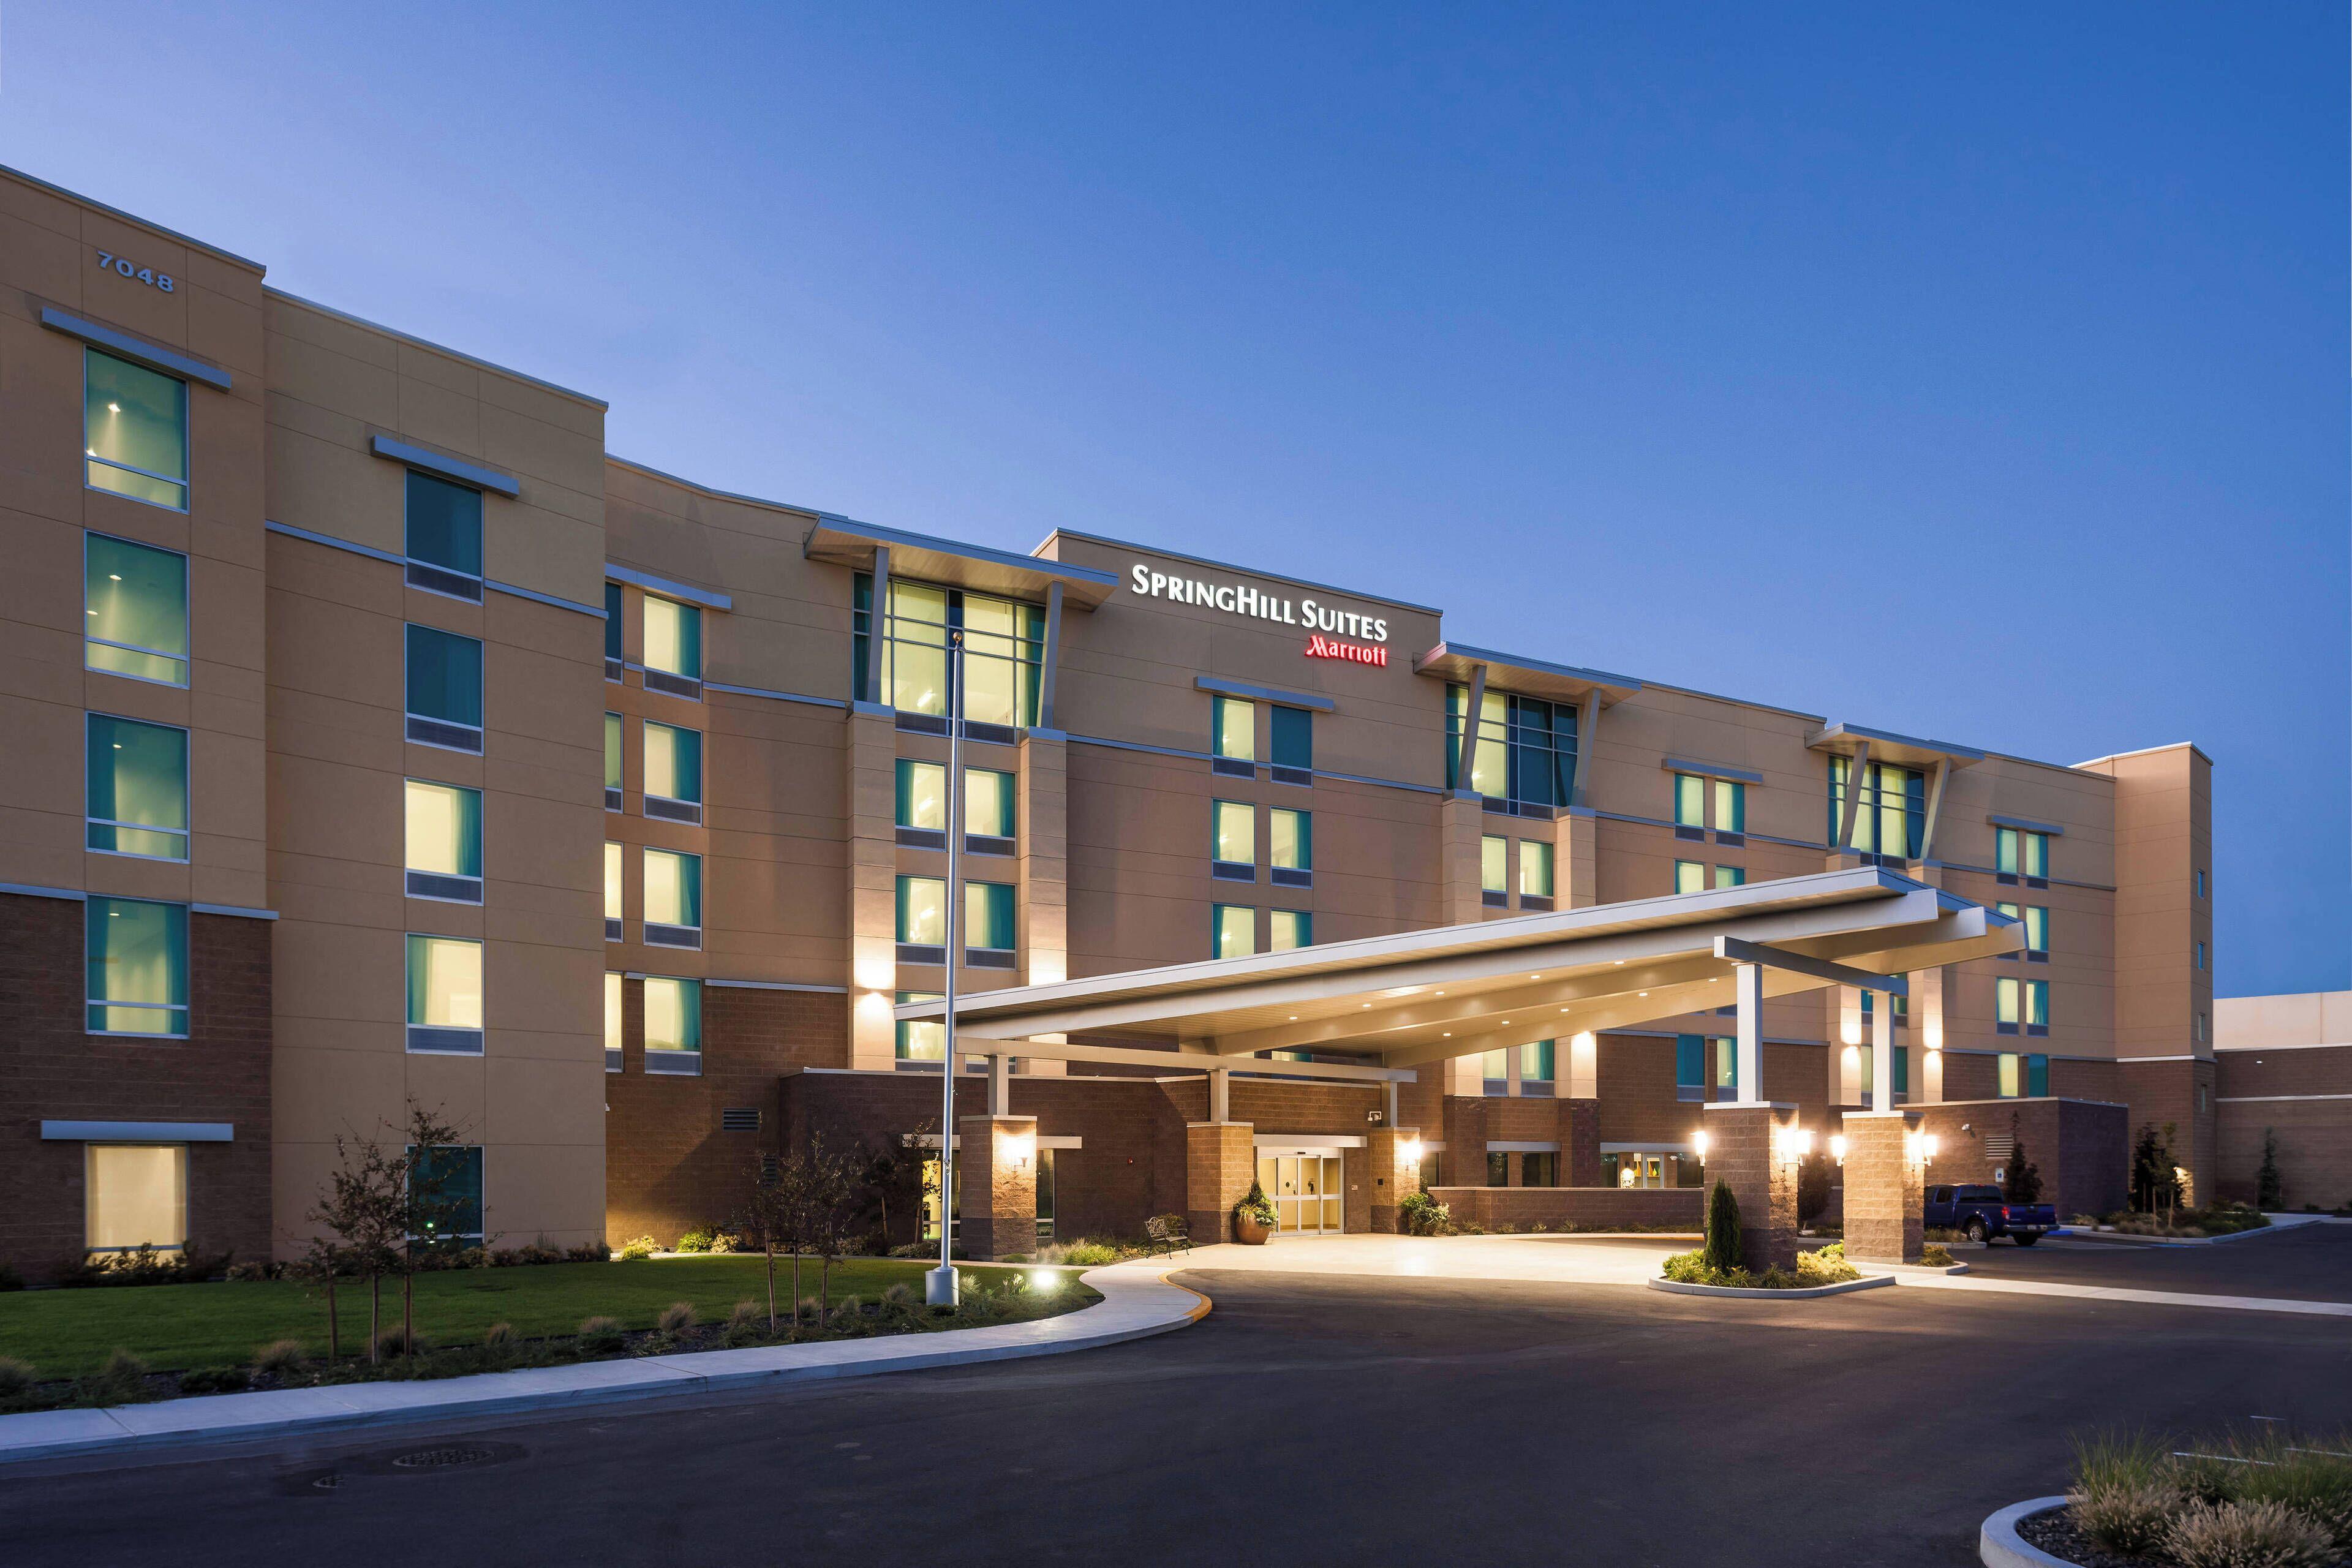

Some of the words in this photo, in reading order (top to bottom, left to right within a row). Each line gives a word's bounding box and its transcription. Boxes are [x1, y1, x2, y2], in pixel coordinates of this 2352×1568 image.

[97, 250, 174, 293] 7048
[1131, 564, 1296, 625] SPRINGHILL
[1301, 600, 1387, 642] SUITES
[1305, 635, 1387, 666] Marriott
